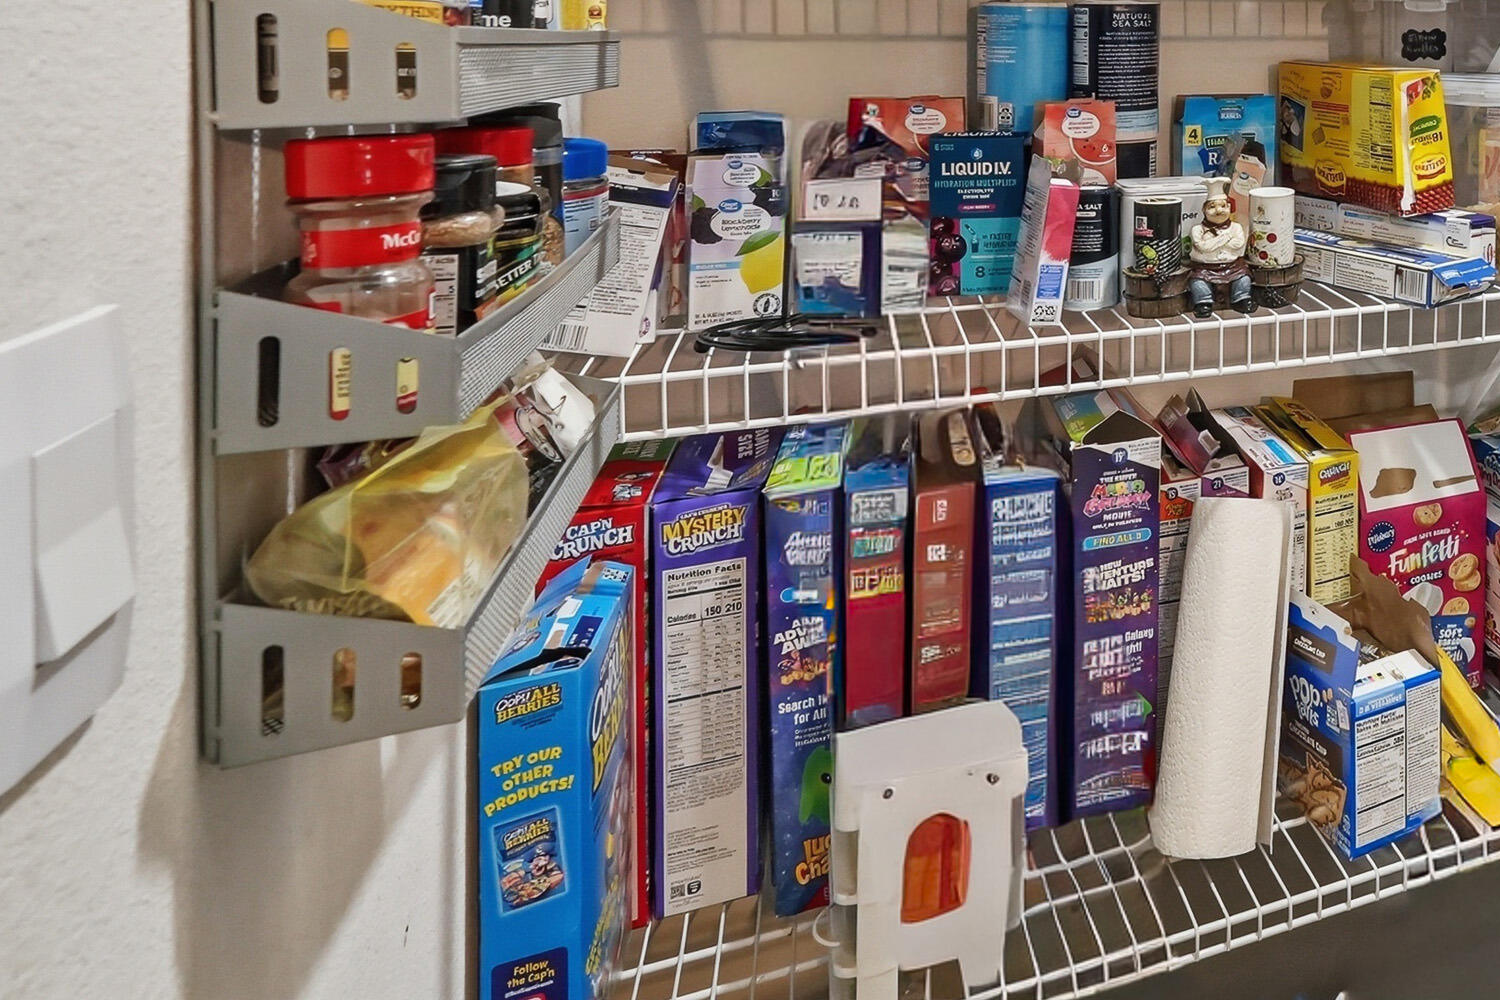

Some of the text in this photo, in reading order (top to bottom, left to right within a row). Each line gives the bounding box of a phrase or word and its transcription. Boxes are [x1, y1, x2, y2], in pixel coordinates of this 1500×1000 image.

[1112, 19, 1133, 27] SEA
[1188, 129, 1198, 139] 4
[941, 162, 993, 176] LIQUID
[975, 266, 985, 277] 8
[566, 517, 613, 539] CAP'N
[662, 505, 747, 542] MYSTERY
[551, 524, 634, 561] CRUNCH
[668, 522, 742, 554] CRUNCH
[1388, 535, 1460, 576] Funfetti
[667, 562, 742, 582] Nutrition Facts
[1410, 570, 1444, 586] COOKIES
[667, 601, 742, 623] Calories 150 210
[1125, 627, 1154, 643] Galaxy
[530, 682, 561, 704] ALL
[496, 693, 561, 724] BERRIES
[777, 697, 816, 715] Search
[793, 711, 810, 725] for
[491, 746, 563, 778] TRY OUR
[501, 764, 555, 791] OTHER
[483, 774, 575, 818] PRODUCTS!
[507, 968, 555, 989] the Cap'n
[513, 959, 549, 978] Follow
